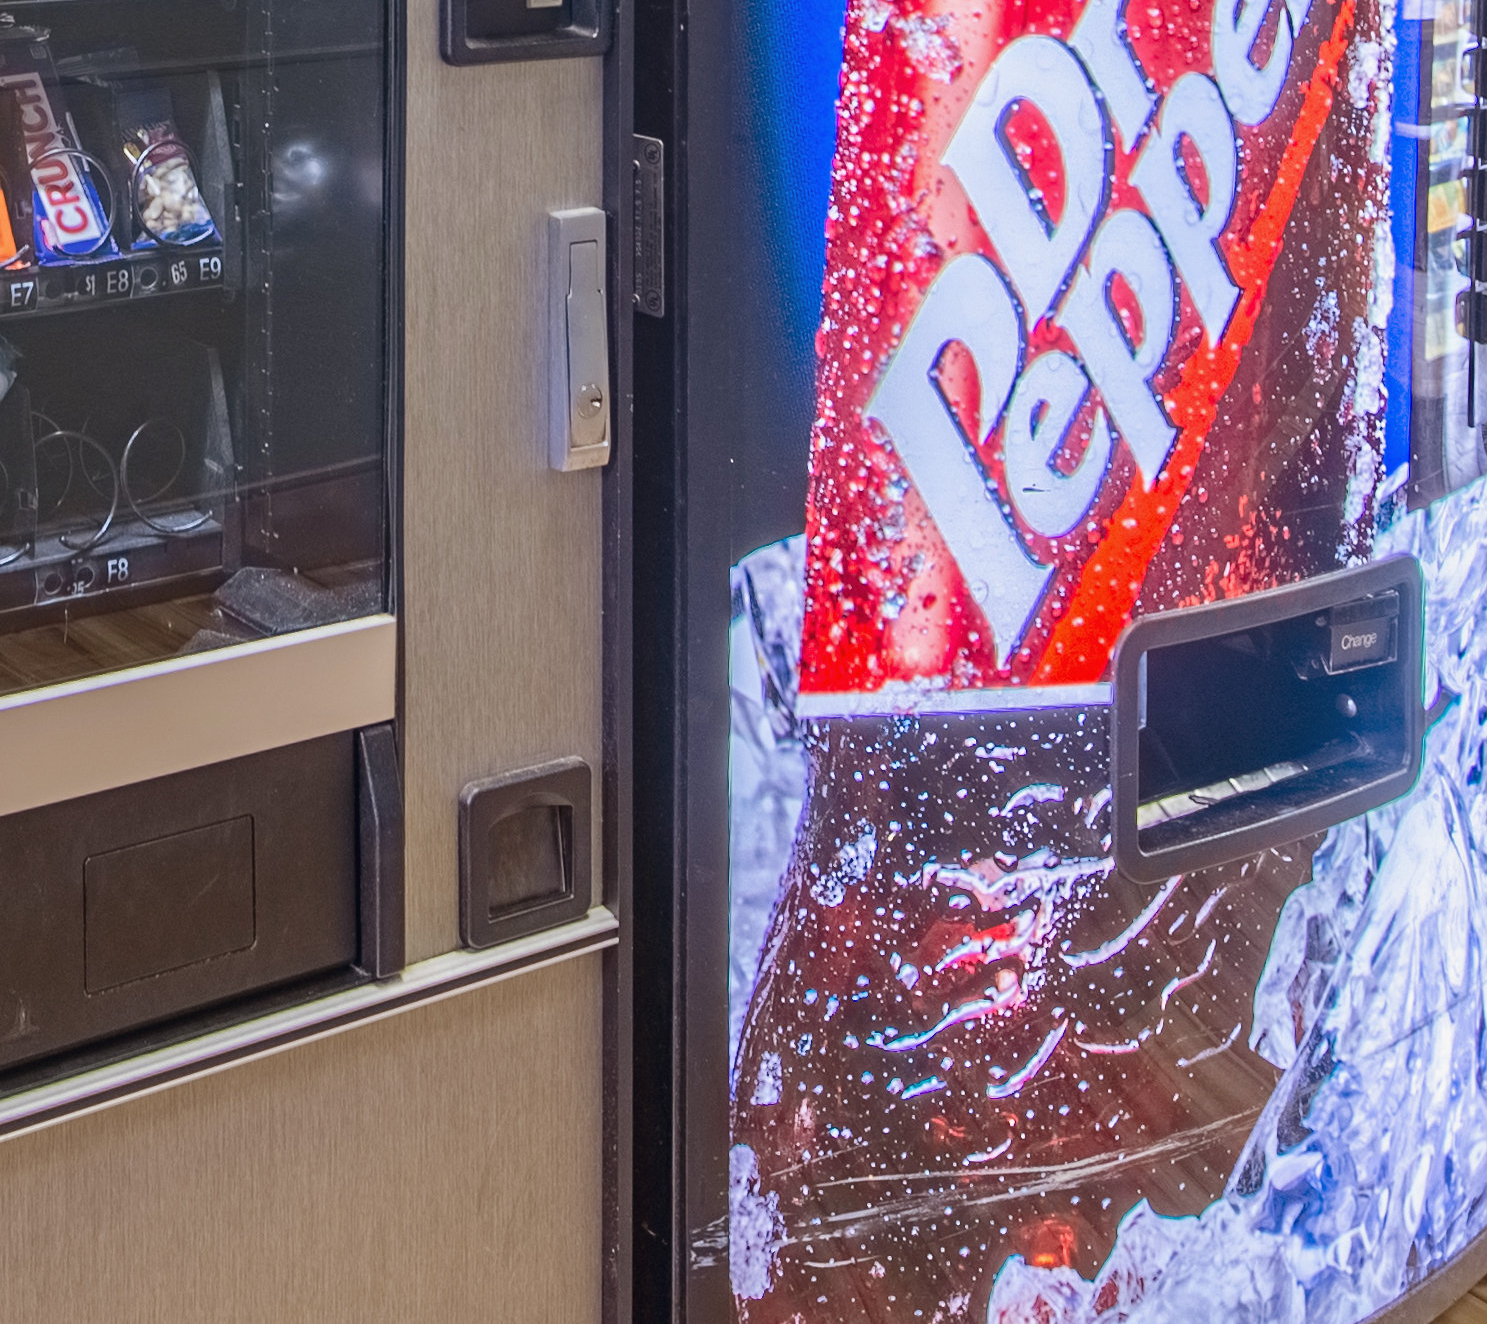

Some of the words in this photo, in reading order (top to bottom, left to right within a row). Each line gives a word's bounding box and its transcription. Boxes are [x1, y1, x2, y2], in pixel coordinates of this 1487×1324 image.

[1, 76, 89, 235] CRUNCH
[199, 257, 222, 281] E9
[10, 281, 34, 308] E7
[106, 270, 130, 295] E8
[107, 557, 129, 583] F8
[1341, 630, 1378, 651] Change
